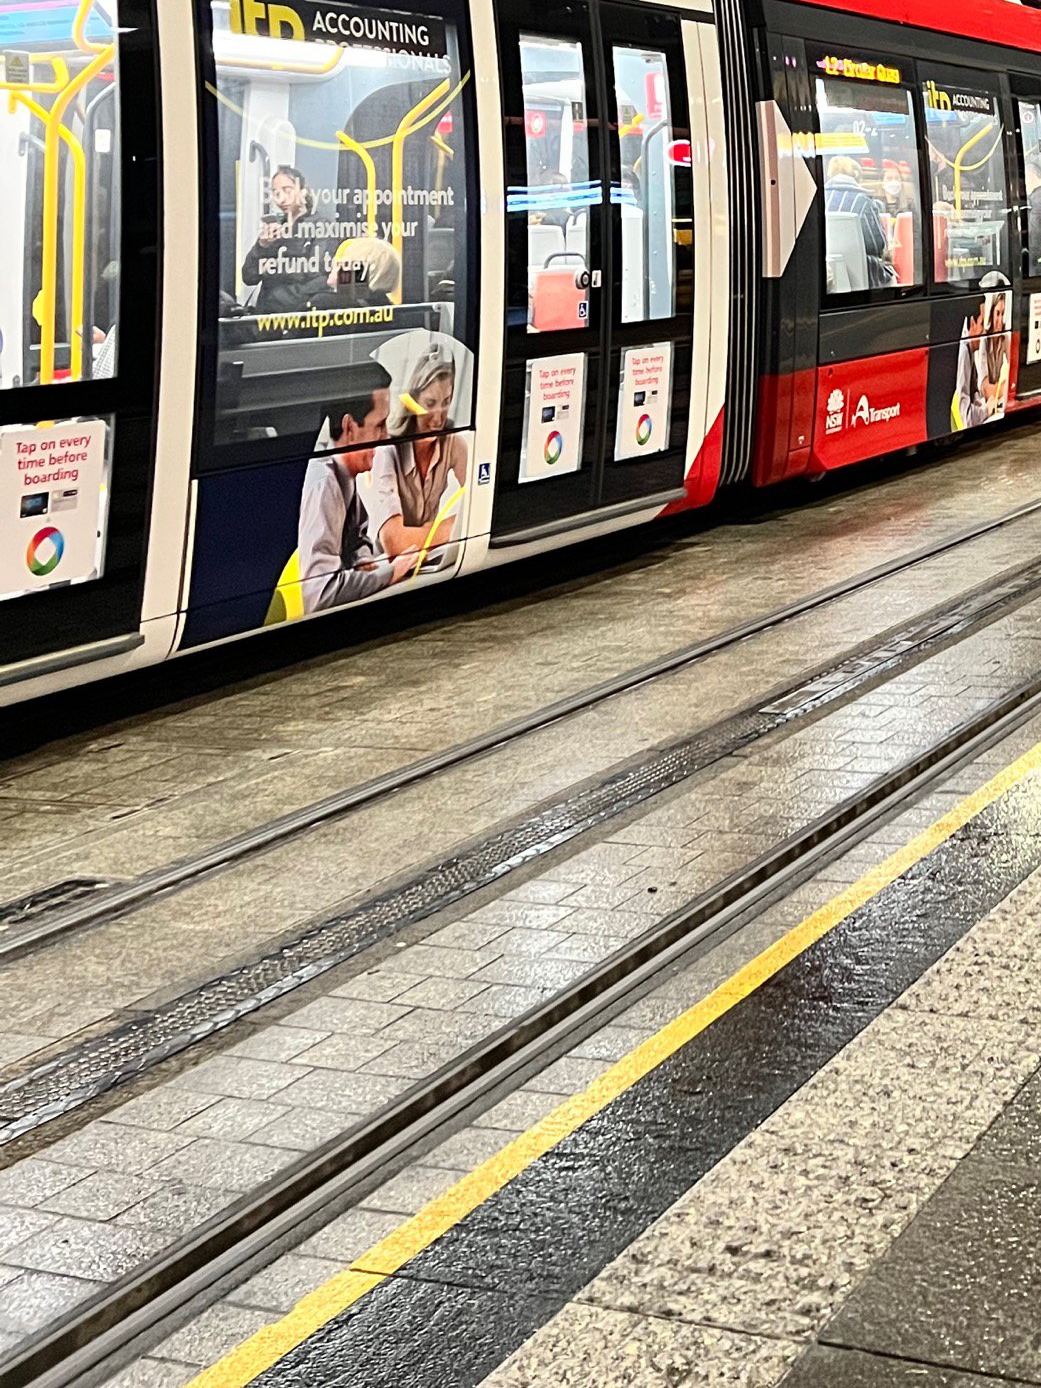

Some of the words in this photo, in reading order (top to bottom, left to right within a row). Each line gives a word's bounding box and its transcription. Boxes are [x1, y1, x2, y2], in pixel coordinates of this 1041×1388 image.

[312, 10, 430, 46] ACCOUNTING
[309, 188, 350, 214] your
[352, 185, 455, 215] appontment
[258, 218, 292, 240] and
[298, 213, 379, 239] maximise
[381, 220, 418, 242] your
[258, 245, 320, 275] refund
[257, 306, 394, 338] www.itp.com.au
[869, 402, 900, 423] Transport
[16, 442, 36, 455] Tap
[40, 440, 56, 452] on
[59, 435, 92, 449] every
[17, 458, 46, 470] time
[48, 451, 88, 466] before
[24, 468, 79, 486] boarding
